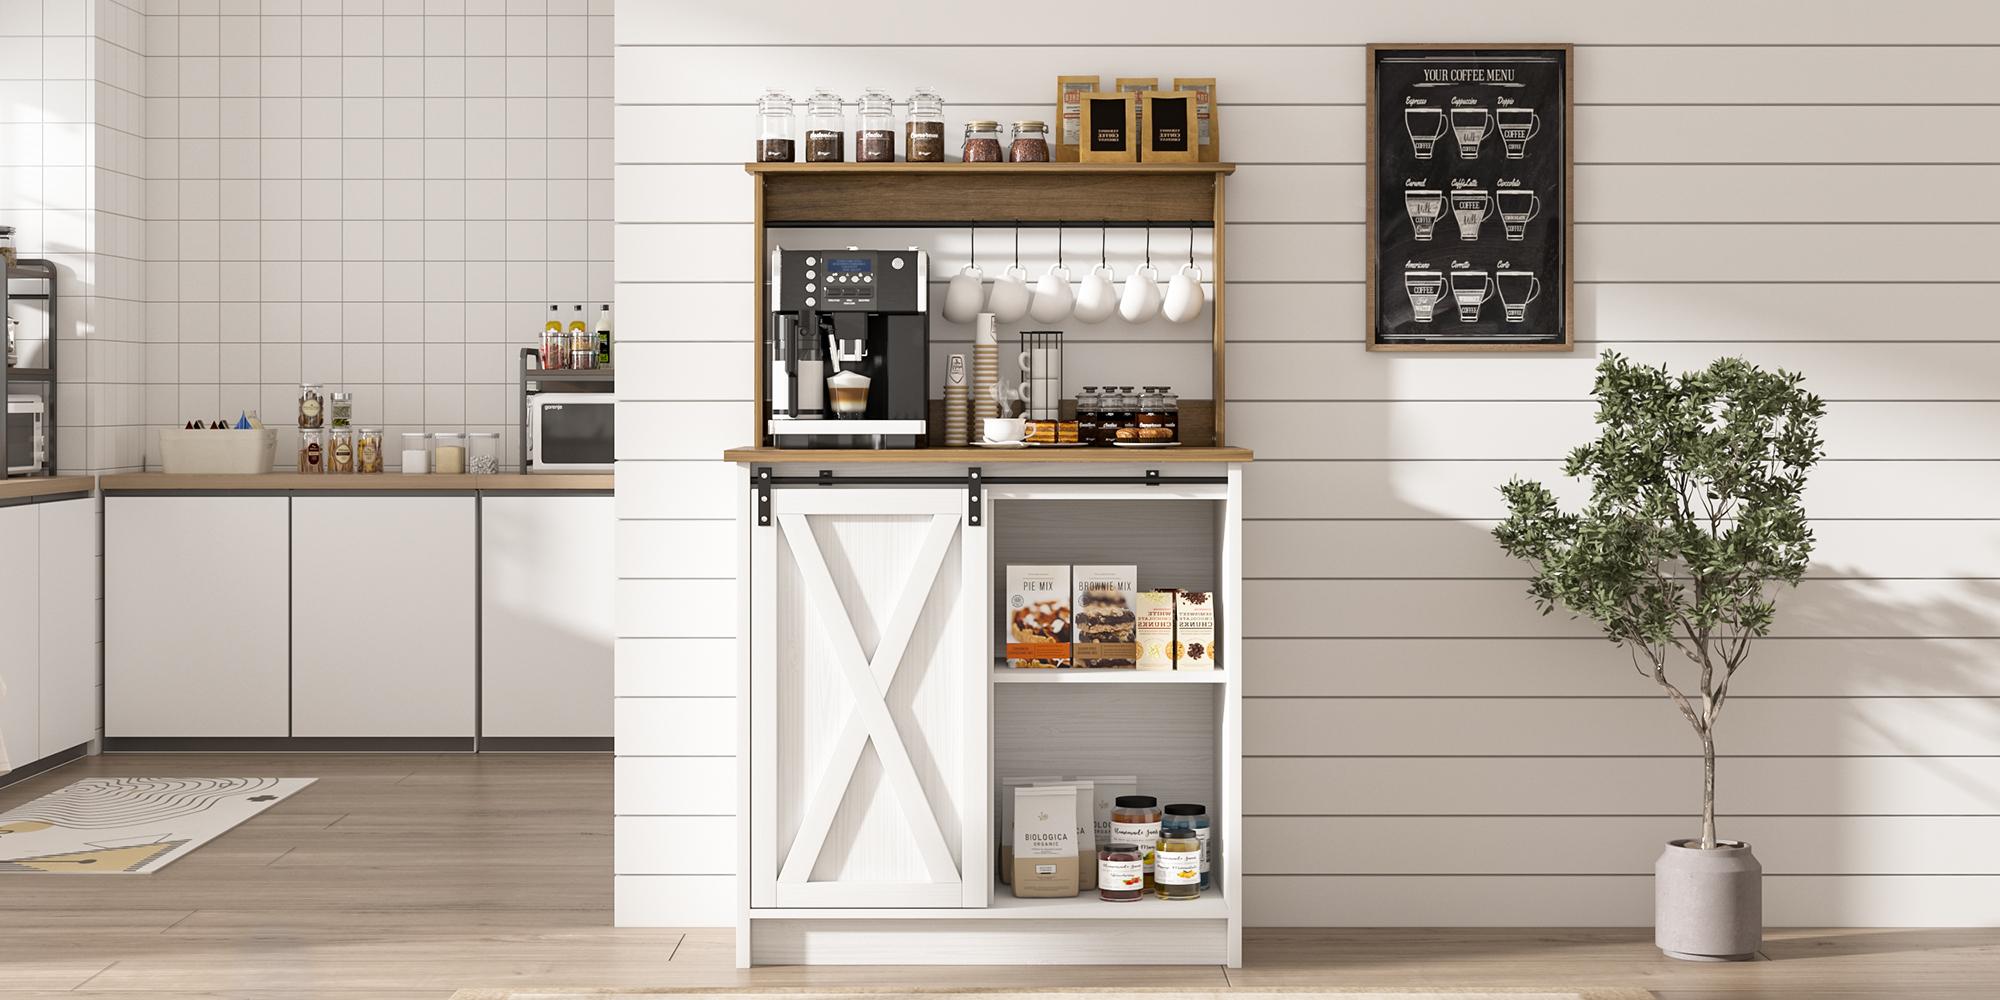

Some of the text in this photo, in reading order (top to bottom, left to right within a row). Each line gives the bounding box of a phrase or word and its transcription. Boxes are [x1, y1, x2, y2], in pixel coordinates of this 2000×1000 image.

[1423, 68, 1515, 81] YOUR COFFEE MENU
[1405, 96, 1427, 107] Espresso
[1450, 96, 1478, 107] Cappuccino
[1497, 96, 1515, 107] Doppio
[1504, 130, 1525, 139] COFFEE
[1459, 201, 1480, 209] COFFEE
[1405, 260, 1430, 268] Americano
[1413, 286, 1434, 294] COFFEE
[1023, 581, 1053, 591] PIE MIX
[1078, 581, 1132, 591] BROWNIE MIX
[1024, 833, 1068, 841] BIOLOGICA
